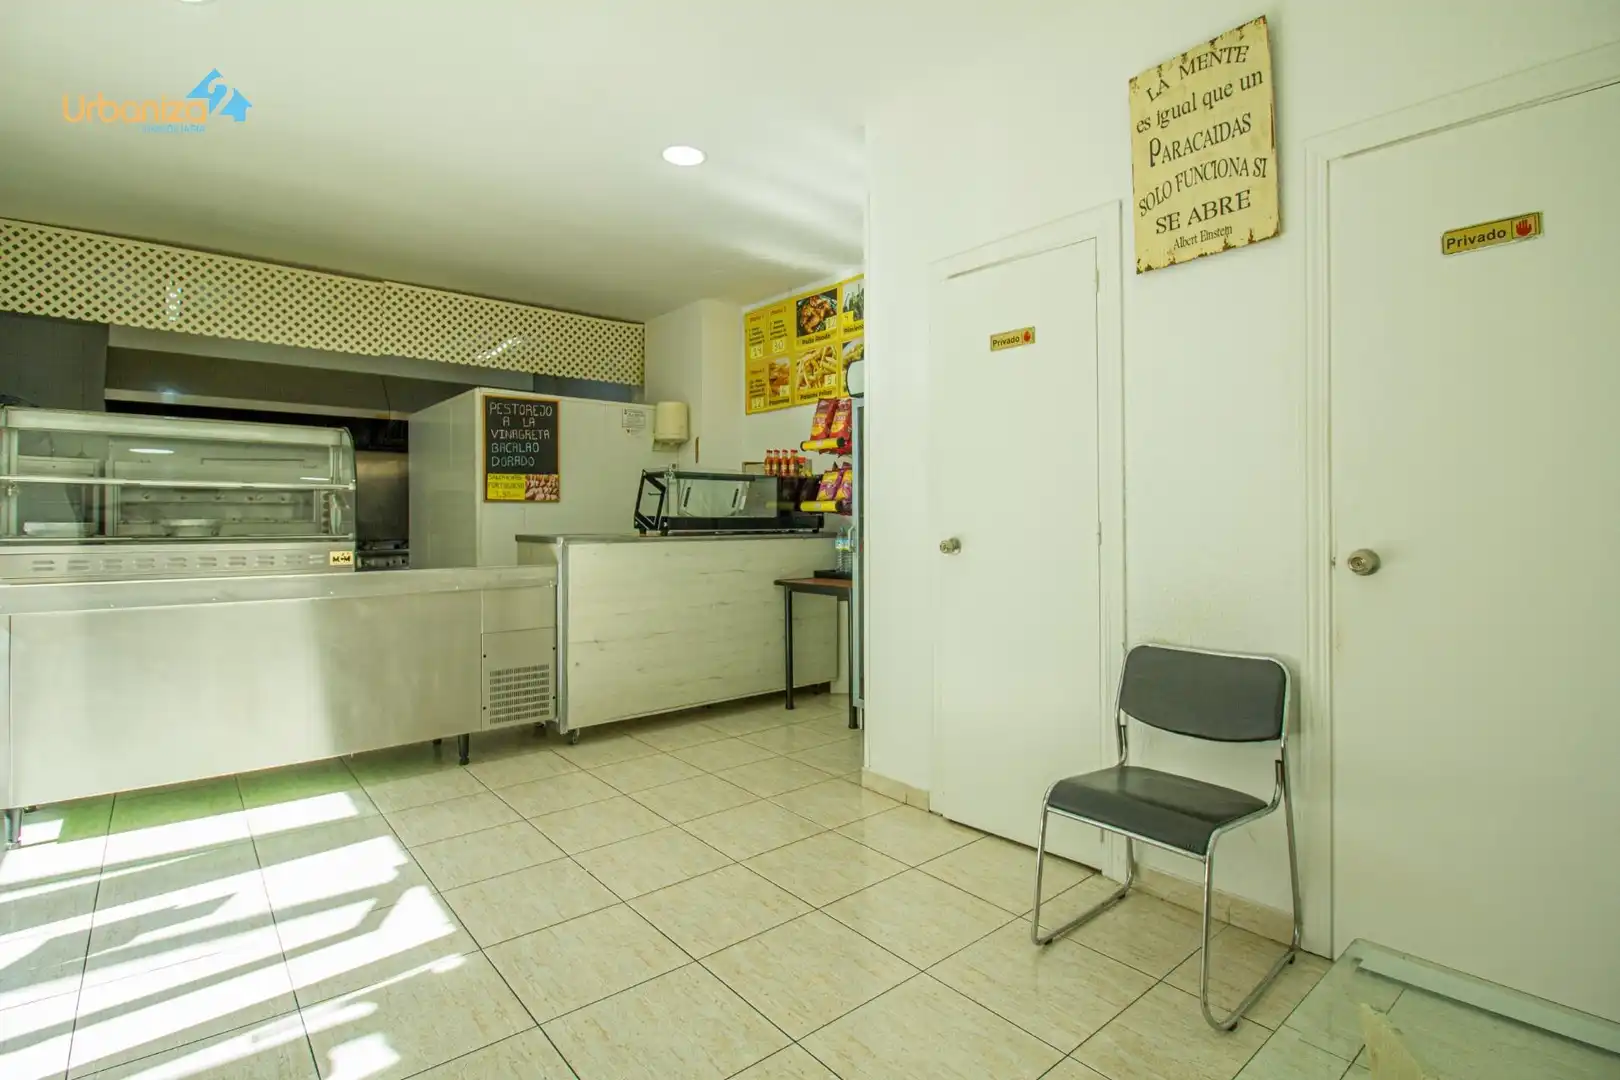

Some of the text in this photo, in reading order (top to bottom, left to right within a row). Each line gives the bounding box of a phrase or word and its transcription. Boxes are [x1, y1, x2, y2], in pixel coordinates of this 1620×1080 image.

[1145, 45, 1249, 102] LA MENTE
[1136, 70, 1263, 134] es igual que un
[1138, 157, 1267, 217] SOLO FUNCIONA SI
[1156, 189, 1252, 234] SE ABRE
[1173, 224, 1233, 252] Albert Einstein
[1447, 229, 1506, 249] Privado
[992, 336, 1020, 348] Privado
[489, 402, 553, 416] PESTOREJO
[503, 416, 536, 428] A LA
[490, 428, 551, 440] VINAGRETA
[491, 442, 540, 453] BACALAO
[491, 456, 535, 468] DORADO
